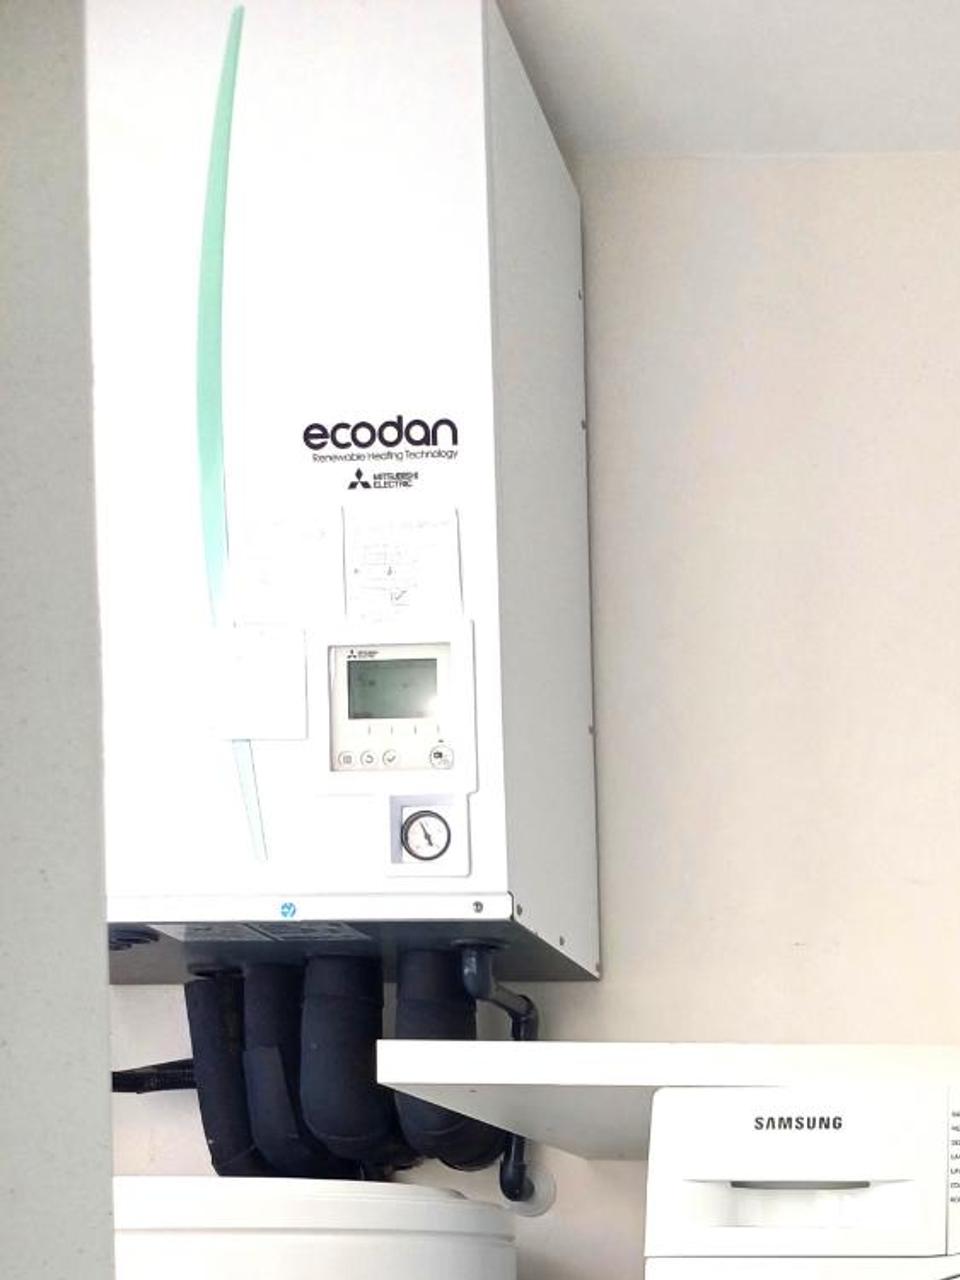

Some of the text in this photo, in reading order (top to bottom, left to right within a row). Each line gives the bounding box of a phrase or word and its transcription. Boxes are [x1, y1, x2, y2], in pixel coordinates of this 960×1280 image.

[303, 415, 458, 450] ecodan
[405, 449, 458, 461] Technology
[754, 1116, 842, 1130] SAMSUNG
